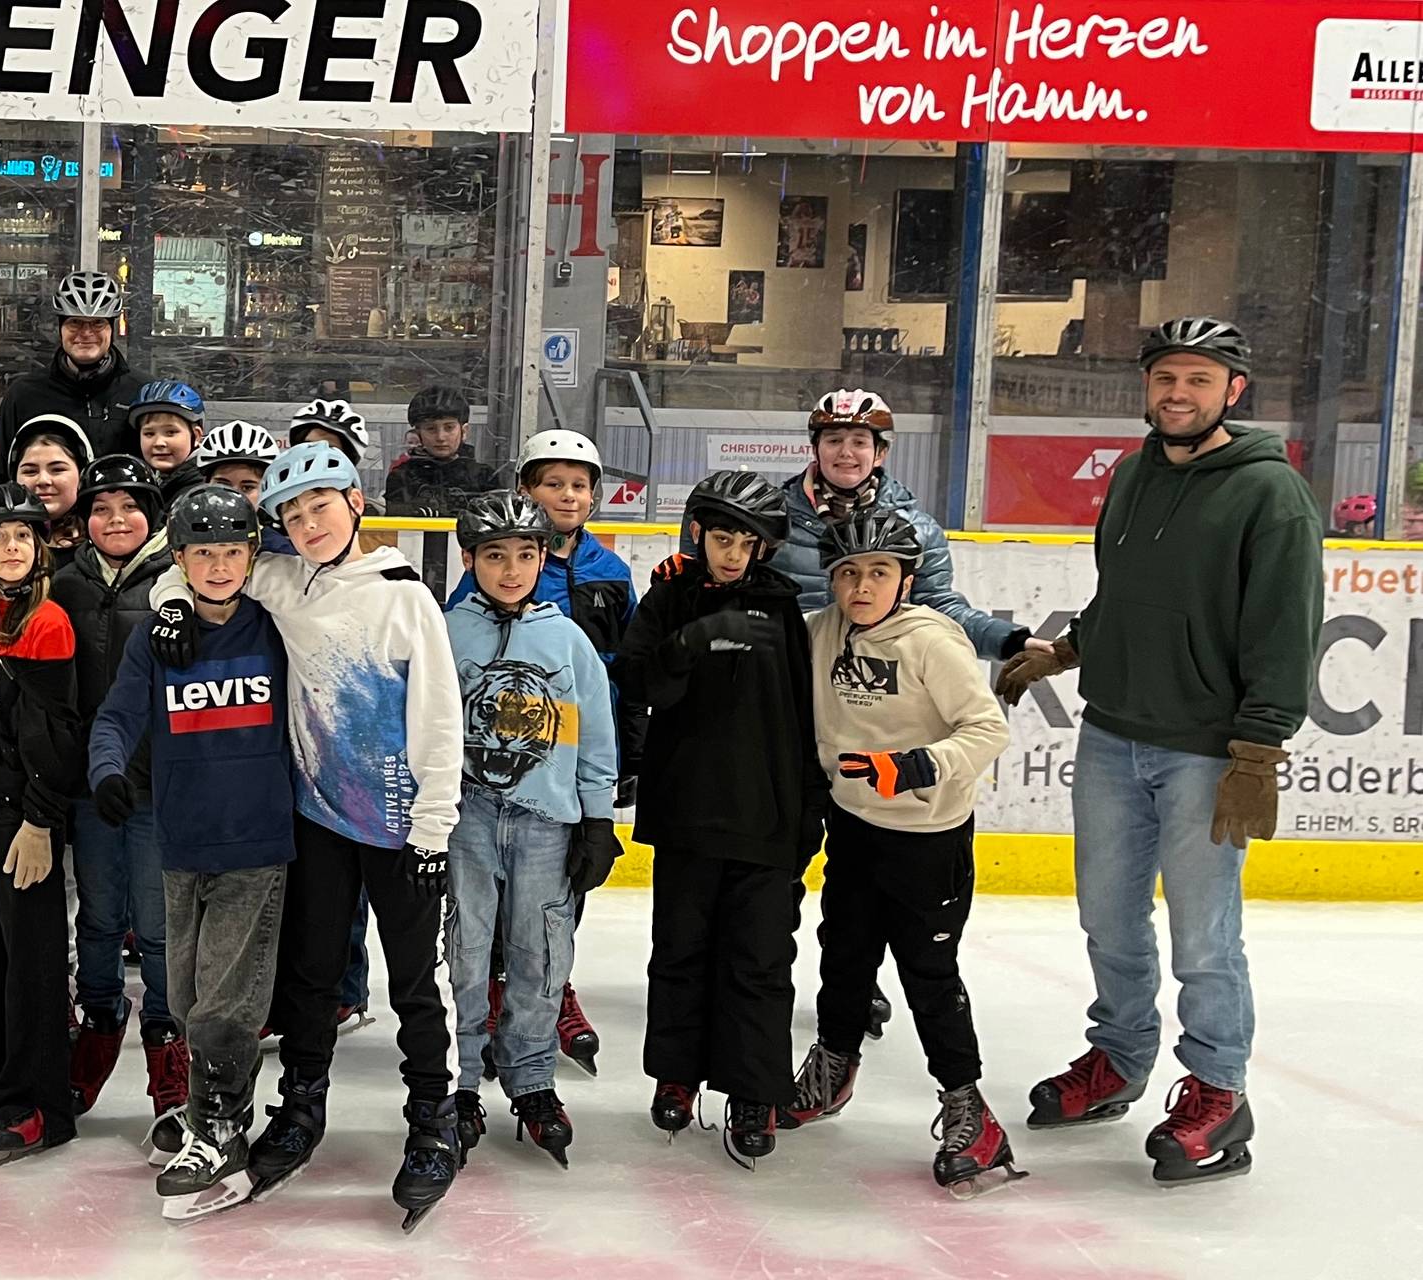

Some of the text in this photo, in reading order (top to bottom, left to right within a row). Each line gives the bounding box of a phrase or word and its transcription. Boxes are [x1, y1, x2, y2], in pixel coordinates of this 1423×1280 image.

[666, 3, 1209, 82] Shoppen im Herzen
[1351, 52, 1423, 84] ALLE
[858, 67, 1149, 129] von Hamm.
[721, 443, 788, 455] CHRISTOPH
[1324, 560, 1423, 595] rbet
[151, 625, 180, 639] FOX
[383, 755, 399, 835] ACTIVE VIBES
[1295, 814, 1360, 833] EHEM.
[1393, 816, 1423, 833] BR
[418, 860, 447, 874] FOX
